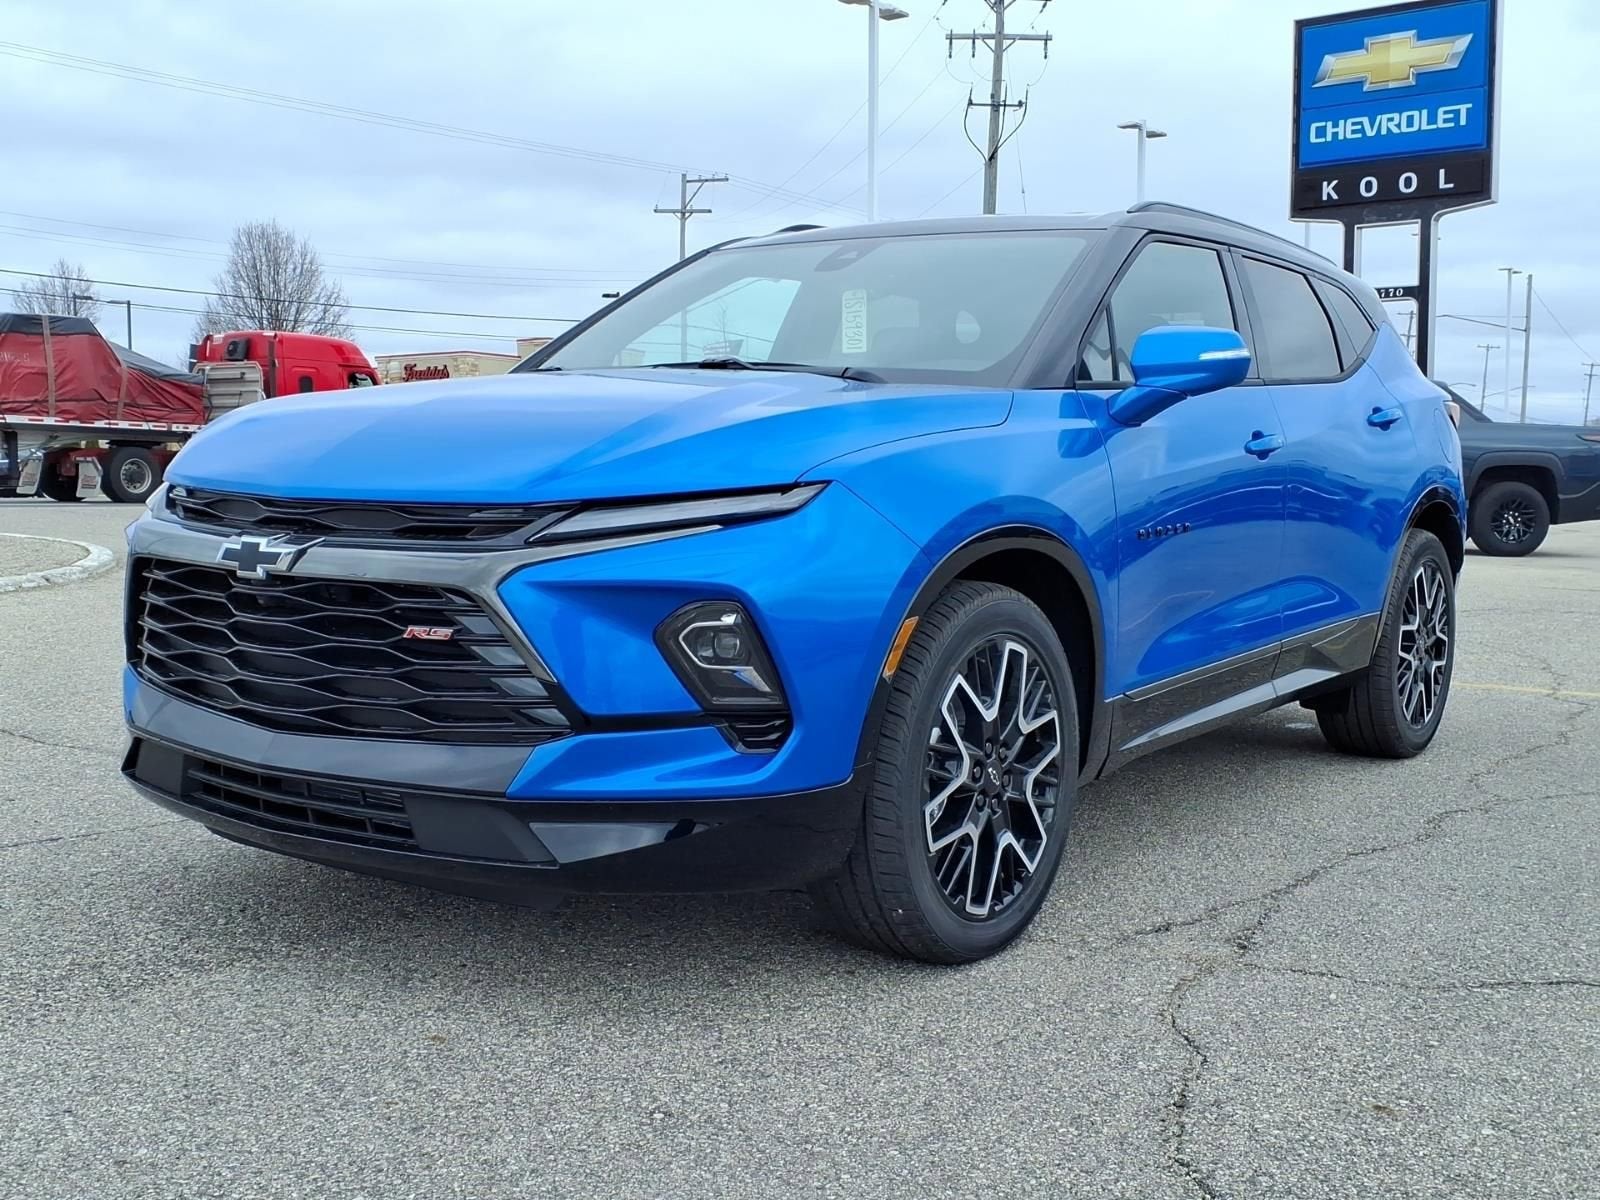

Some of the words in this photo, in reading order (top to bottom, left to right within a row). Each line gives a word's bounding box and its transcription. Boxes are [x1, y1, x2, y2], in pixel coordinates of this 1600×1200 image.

[1309, 103, 1473, 144] CHEVROLET
[1321, 168, 1455, 201] KOOL
[402, 625, 454, 640] RS
